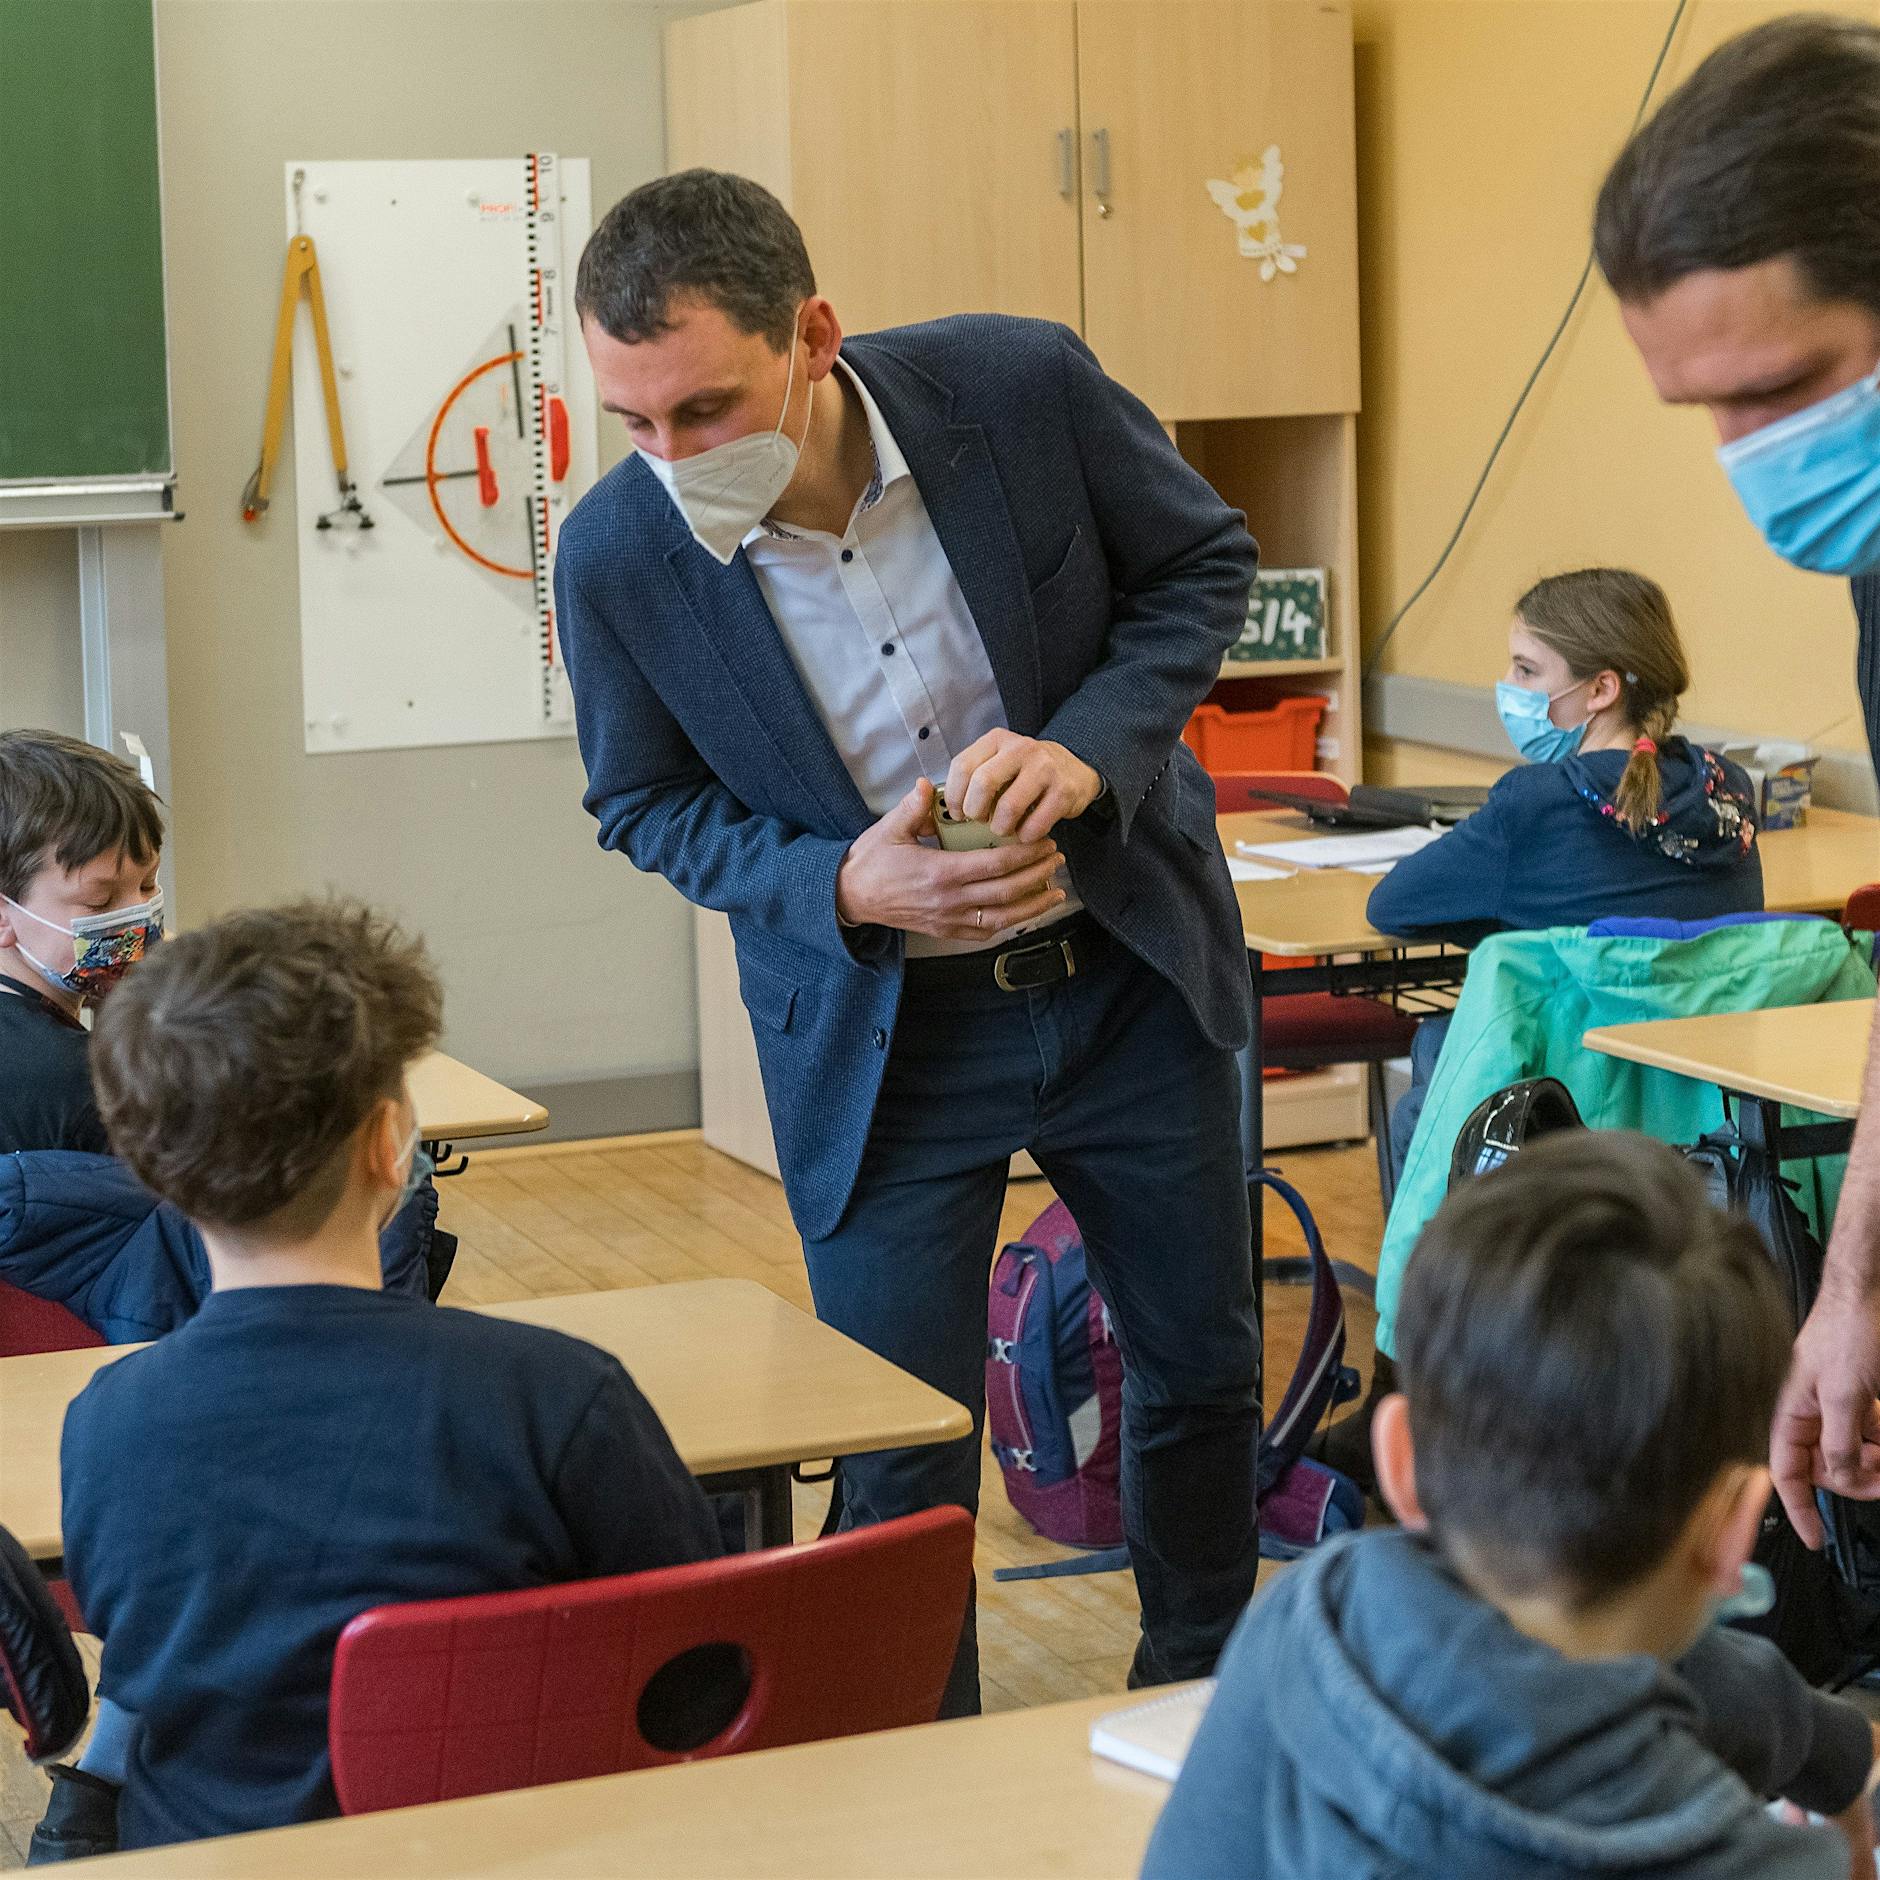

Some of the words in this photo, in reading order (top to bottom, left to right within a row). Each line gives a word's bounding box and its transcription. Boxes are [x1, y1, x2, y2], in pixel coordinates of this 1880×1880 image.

[538, 155, 553, 174] 10
[540, 212, 555, 223] 9
[543, 269, 557, 280] 8
[544, 327, 558, 336] 7
[548, 383, 560, 394] 6
